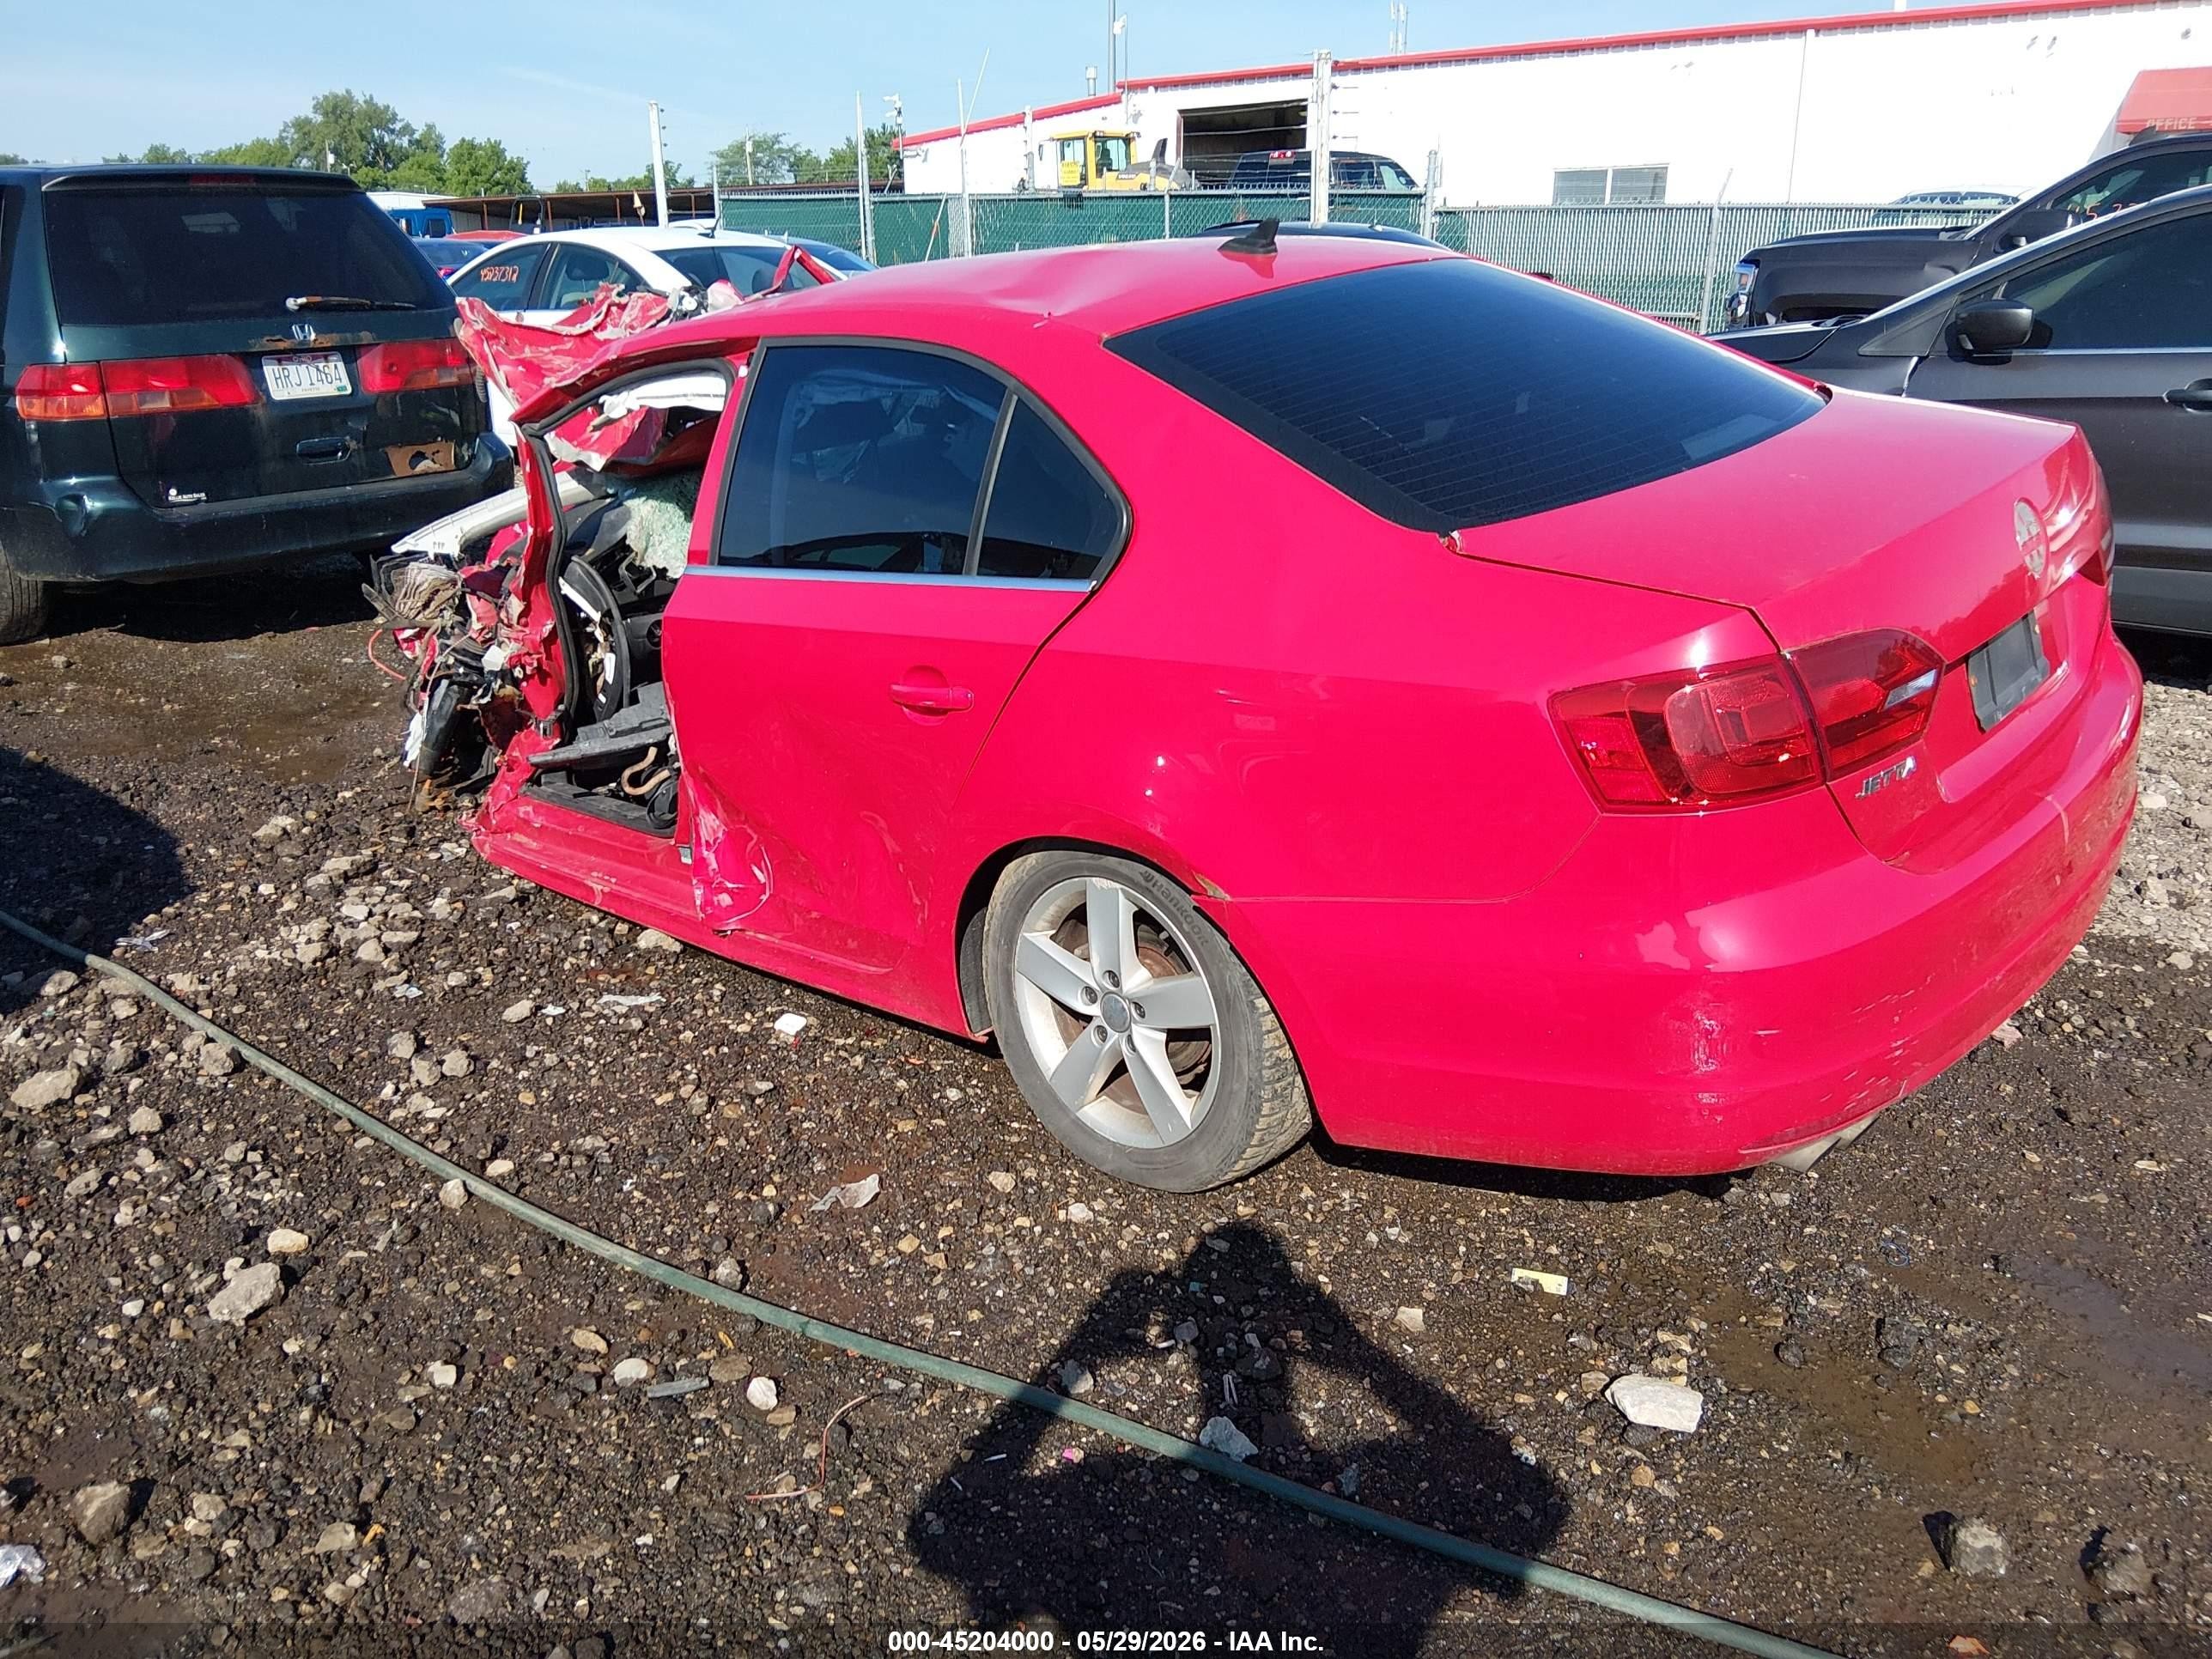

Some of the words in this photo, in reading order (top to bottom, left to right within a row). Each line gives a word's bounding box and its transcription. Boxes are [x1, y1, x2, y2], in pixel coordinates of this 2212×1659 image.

[2147, 117, 2197, 131] OFFICE
[272, 367, 302, 389] HRJ
[306, 364, 343, 386] 1464
